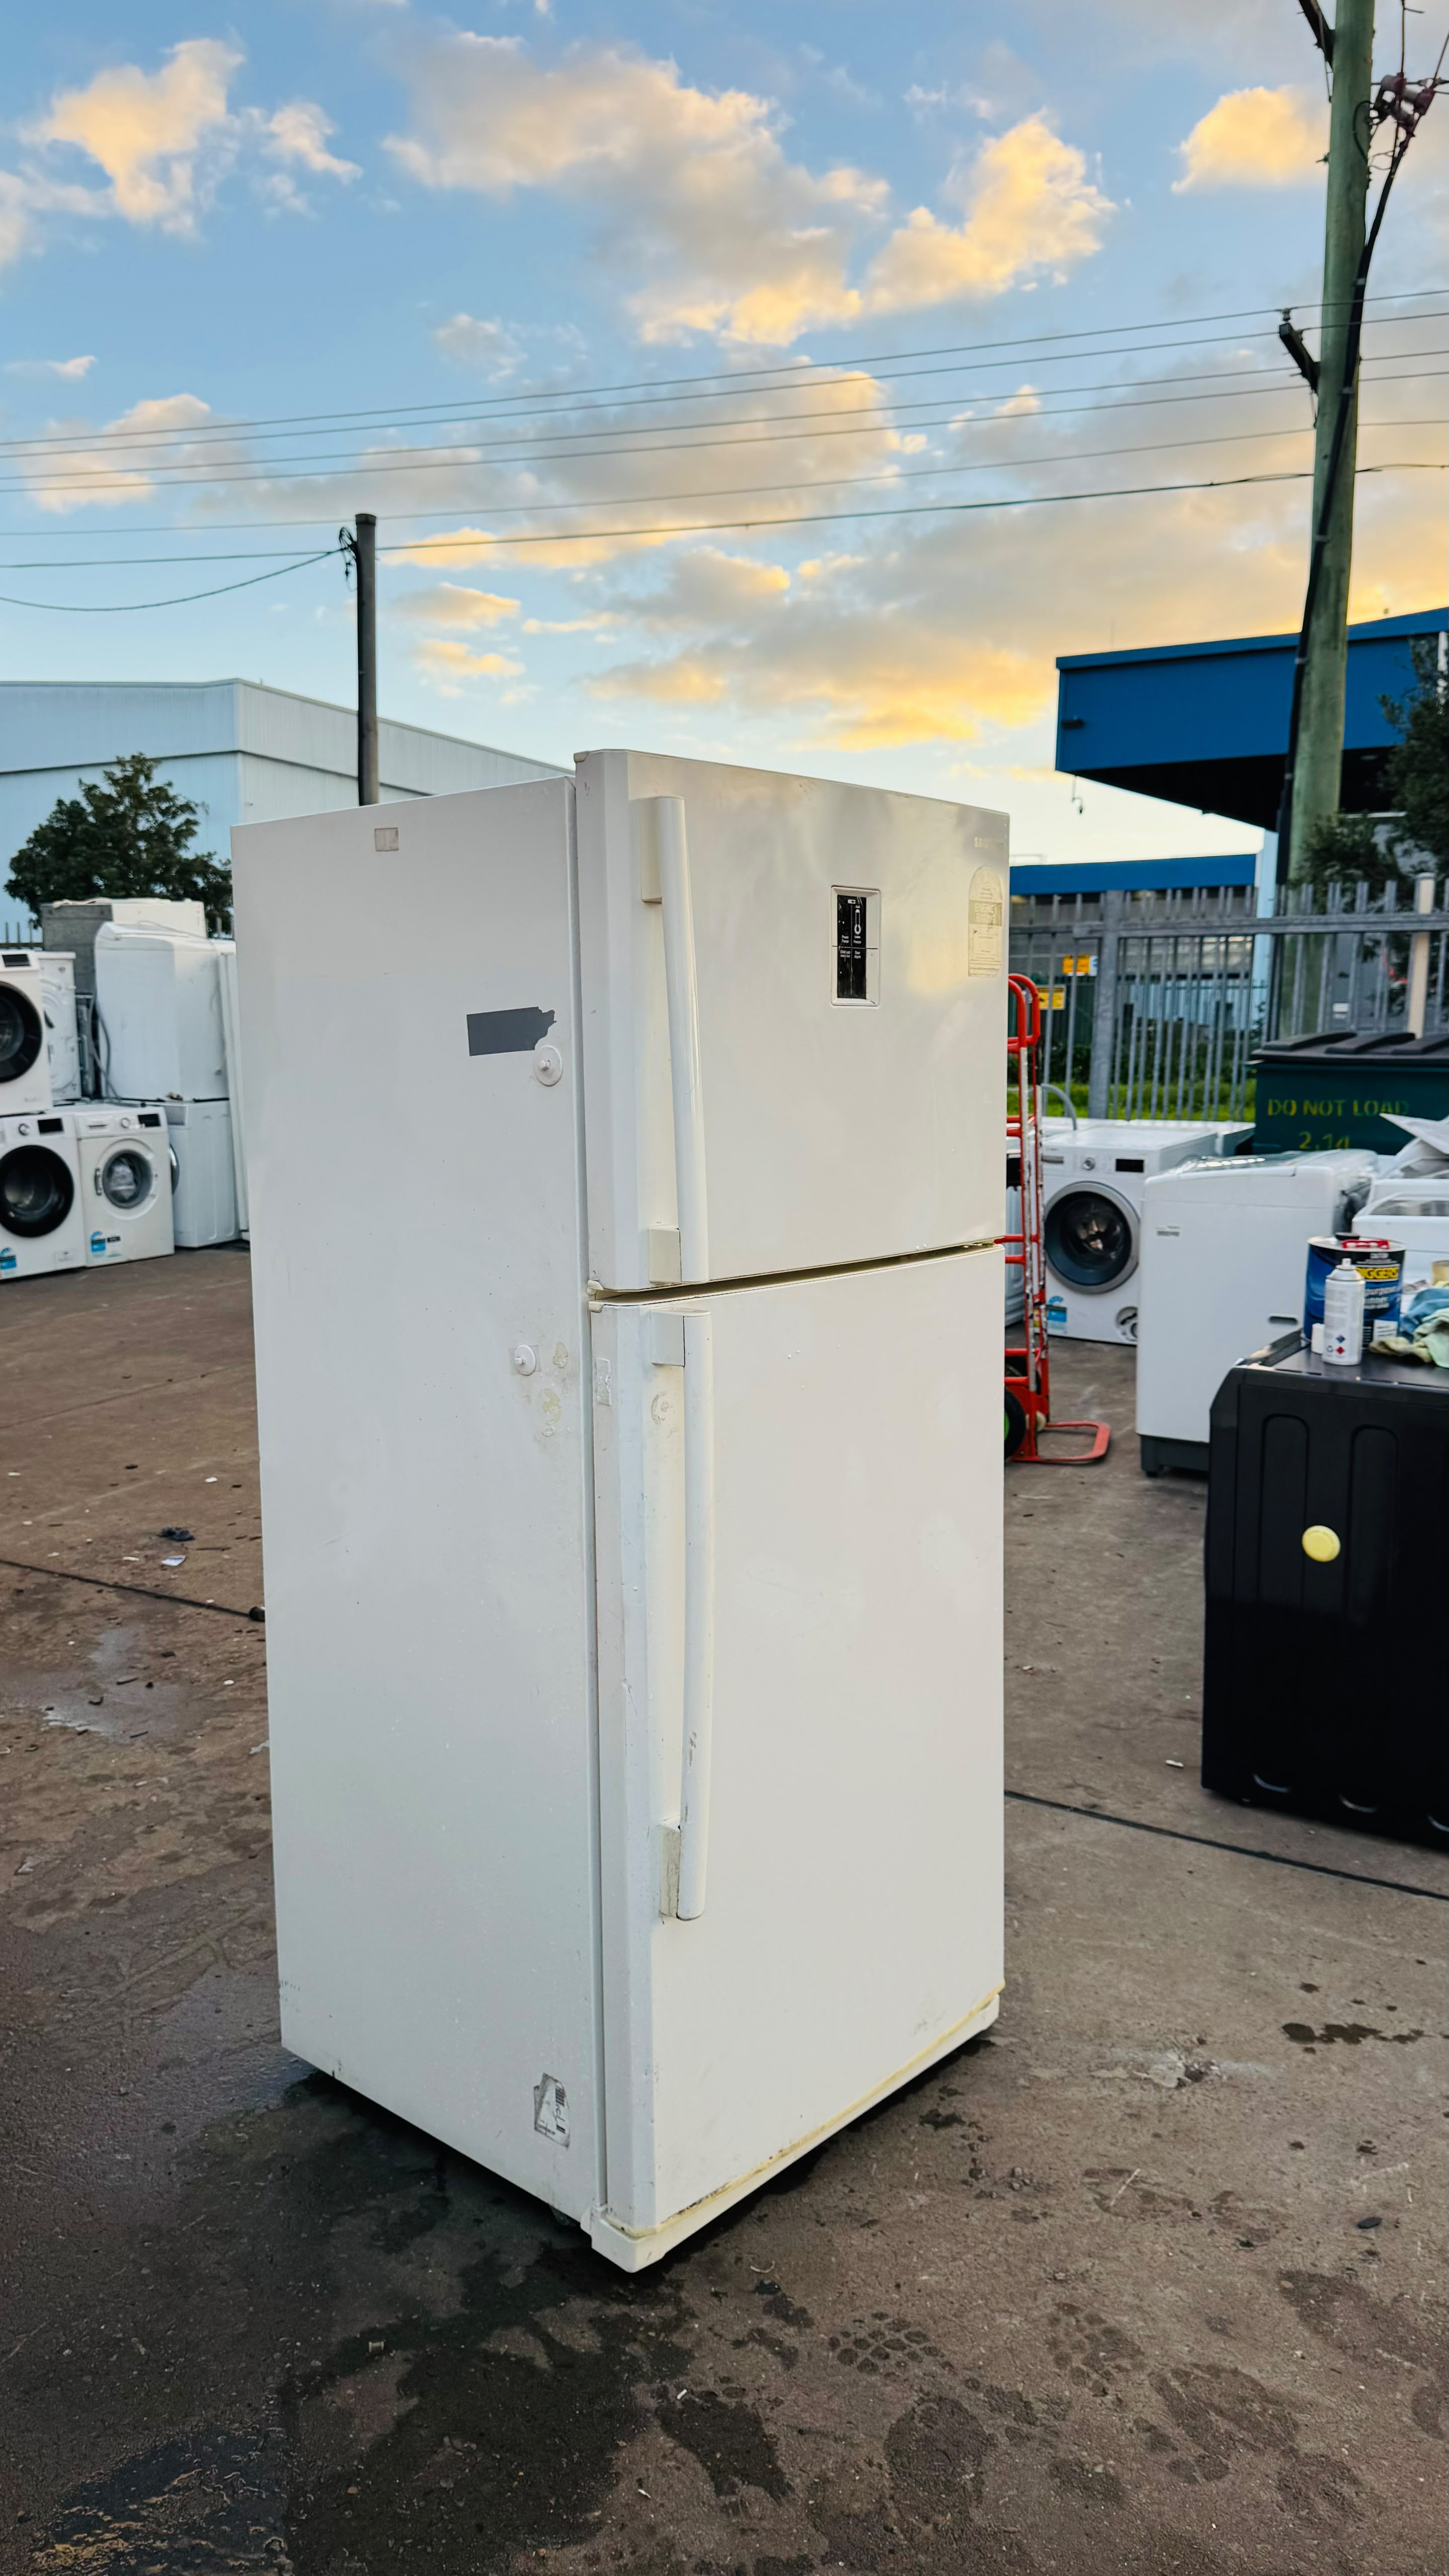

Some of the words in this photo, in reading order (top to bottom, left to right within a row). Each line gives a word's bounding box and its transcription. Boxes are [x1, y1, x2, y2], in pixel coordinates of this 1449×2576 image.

[1268, 1099, 1297, 1116] DO
[1303, 1100, 1346, 1116] NOT
[1352, 1100, 1409, 1116] LOAD
